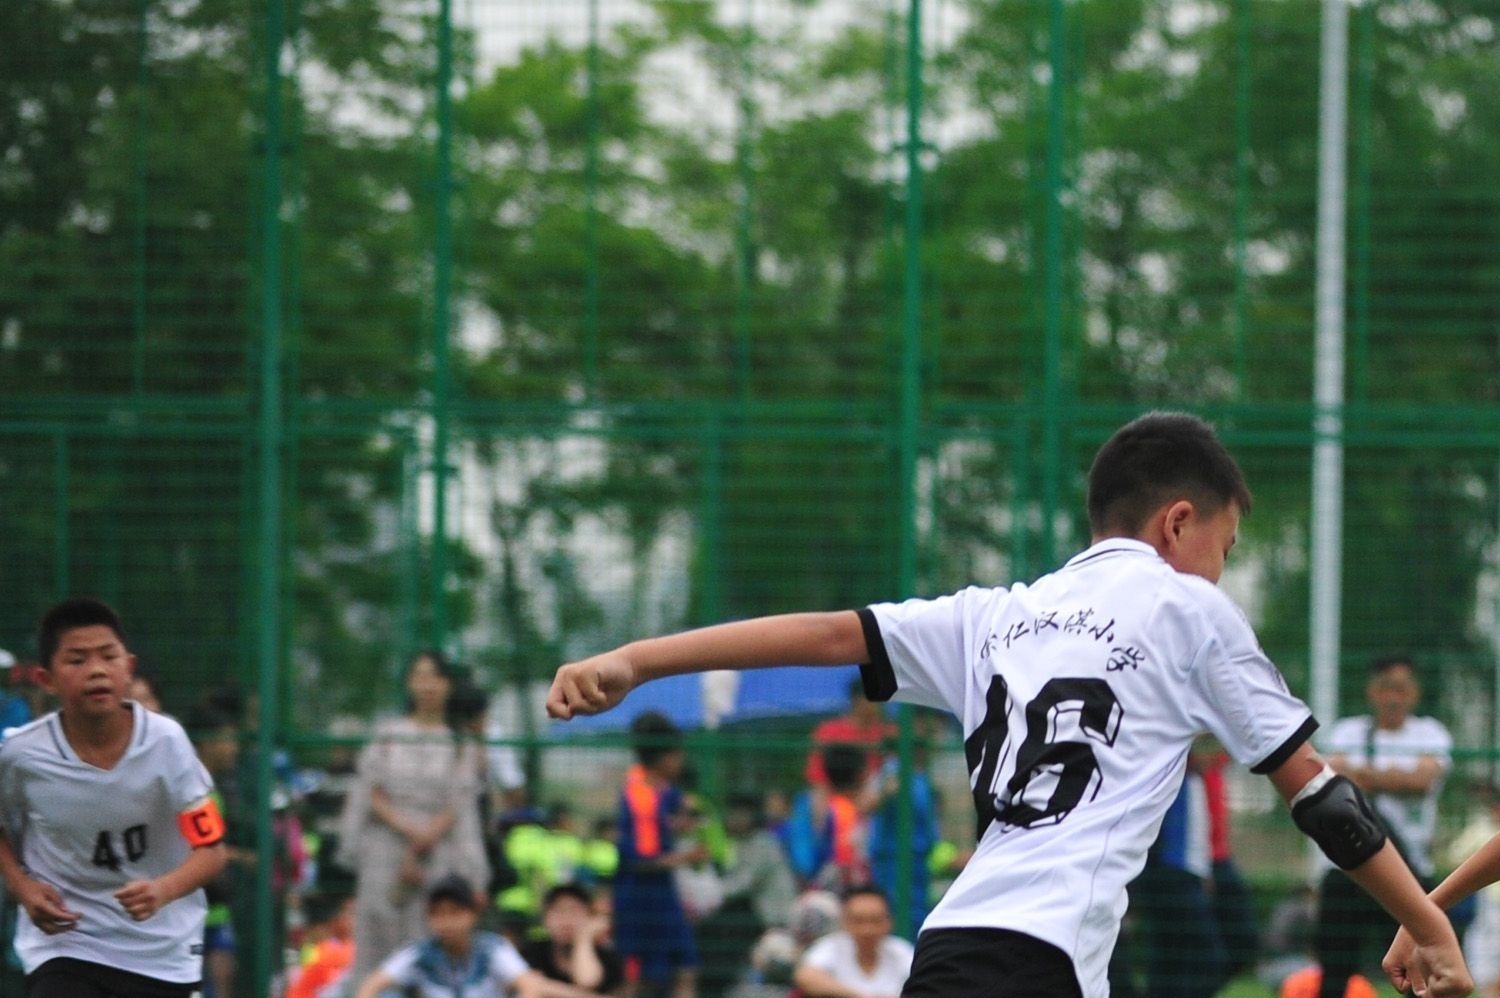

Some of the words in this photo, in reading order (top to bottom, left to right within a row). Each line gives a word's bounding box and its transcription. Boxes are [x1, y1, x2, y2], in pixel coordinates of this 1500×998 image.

[965, 674, 1124, 843] 16
[93, 824, 148, 872] 40
[193, 812, 213, 837] C
